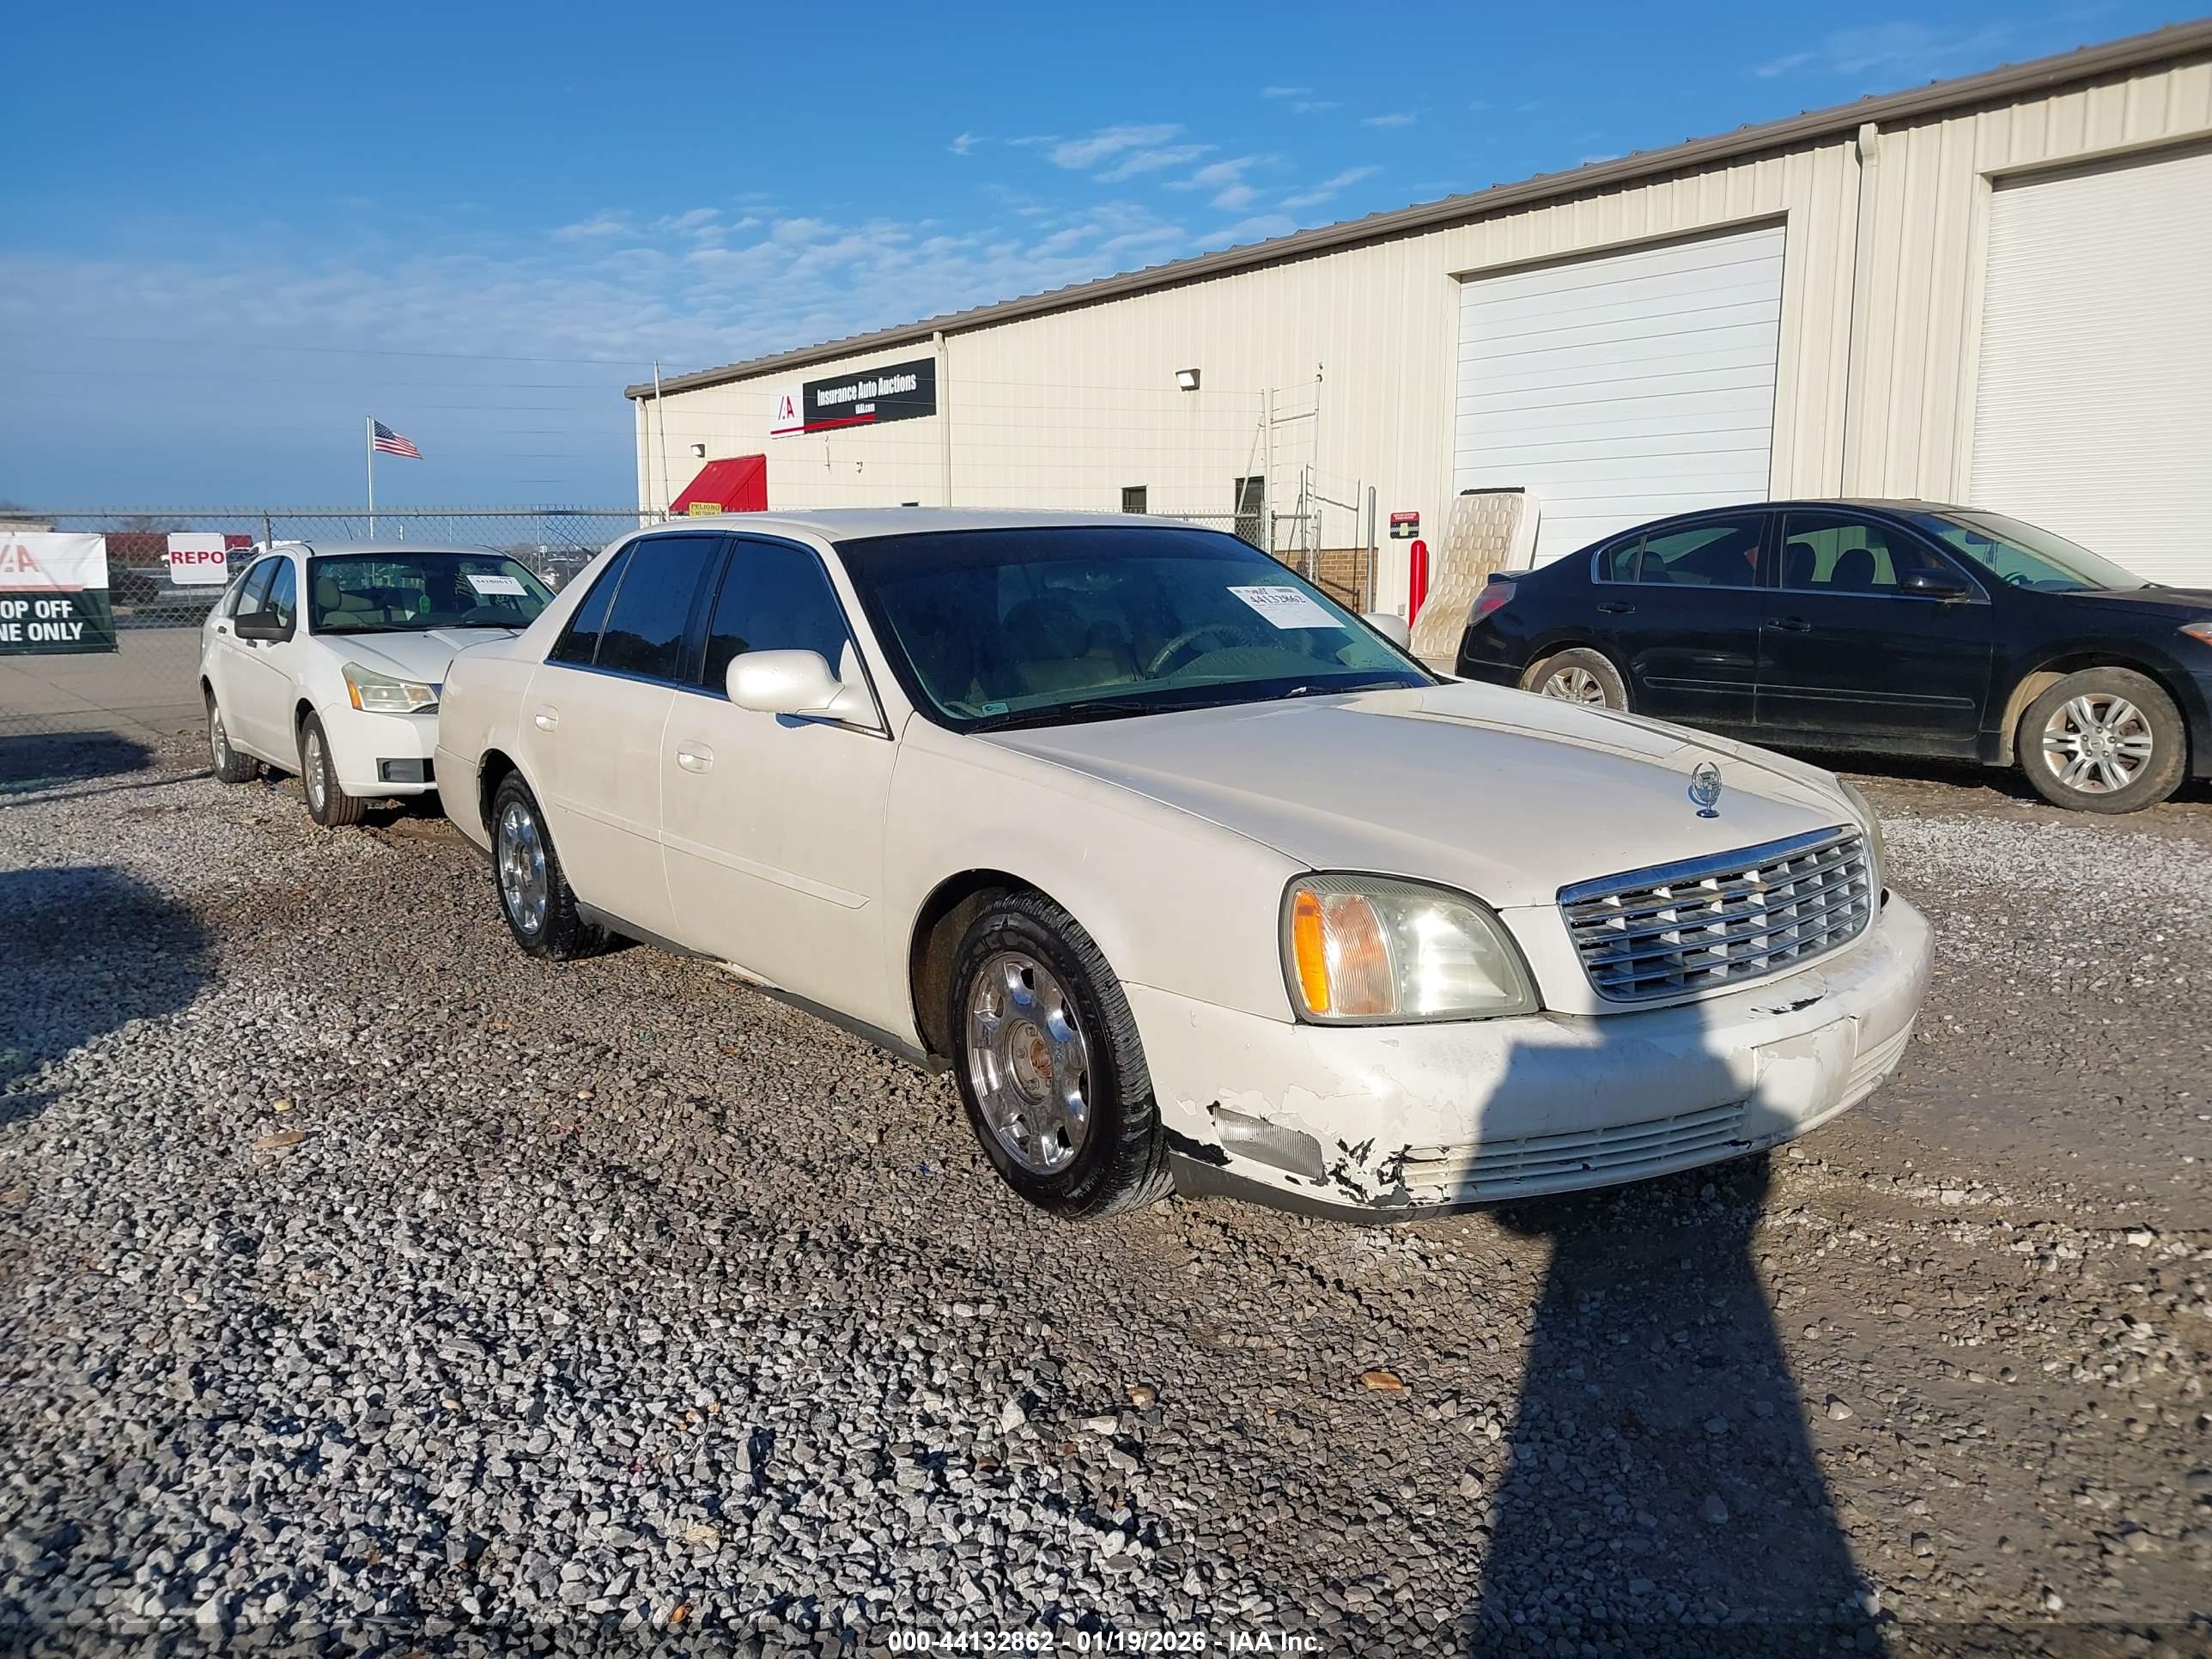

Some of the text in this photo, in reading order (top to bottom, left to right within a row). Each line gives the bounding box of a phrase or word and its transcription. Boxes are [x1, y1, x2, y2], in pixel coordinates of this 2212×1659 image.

[817, 373, 917, 407] Insurance Auto Auctions
[172, 551, 225, 565] REPO
[1249, 595, 1306, 604] 44132862
[35, 600, 73, 618] OFF
[28, 622, 83, 641] ONLY
